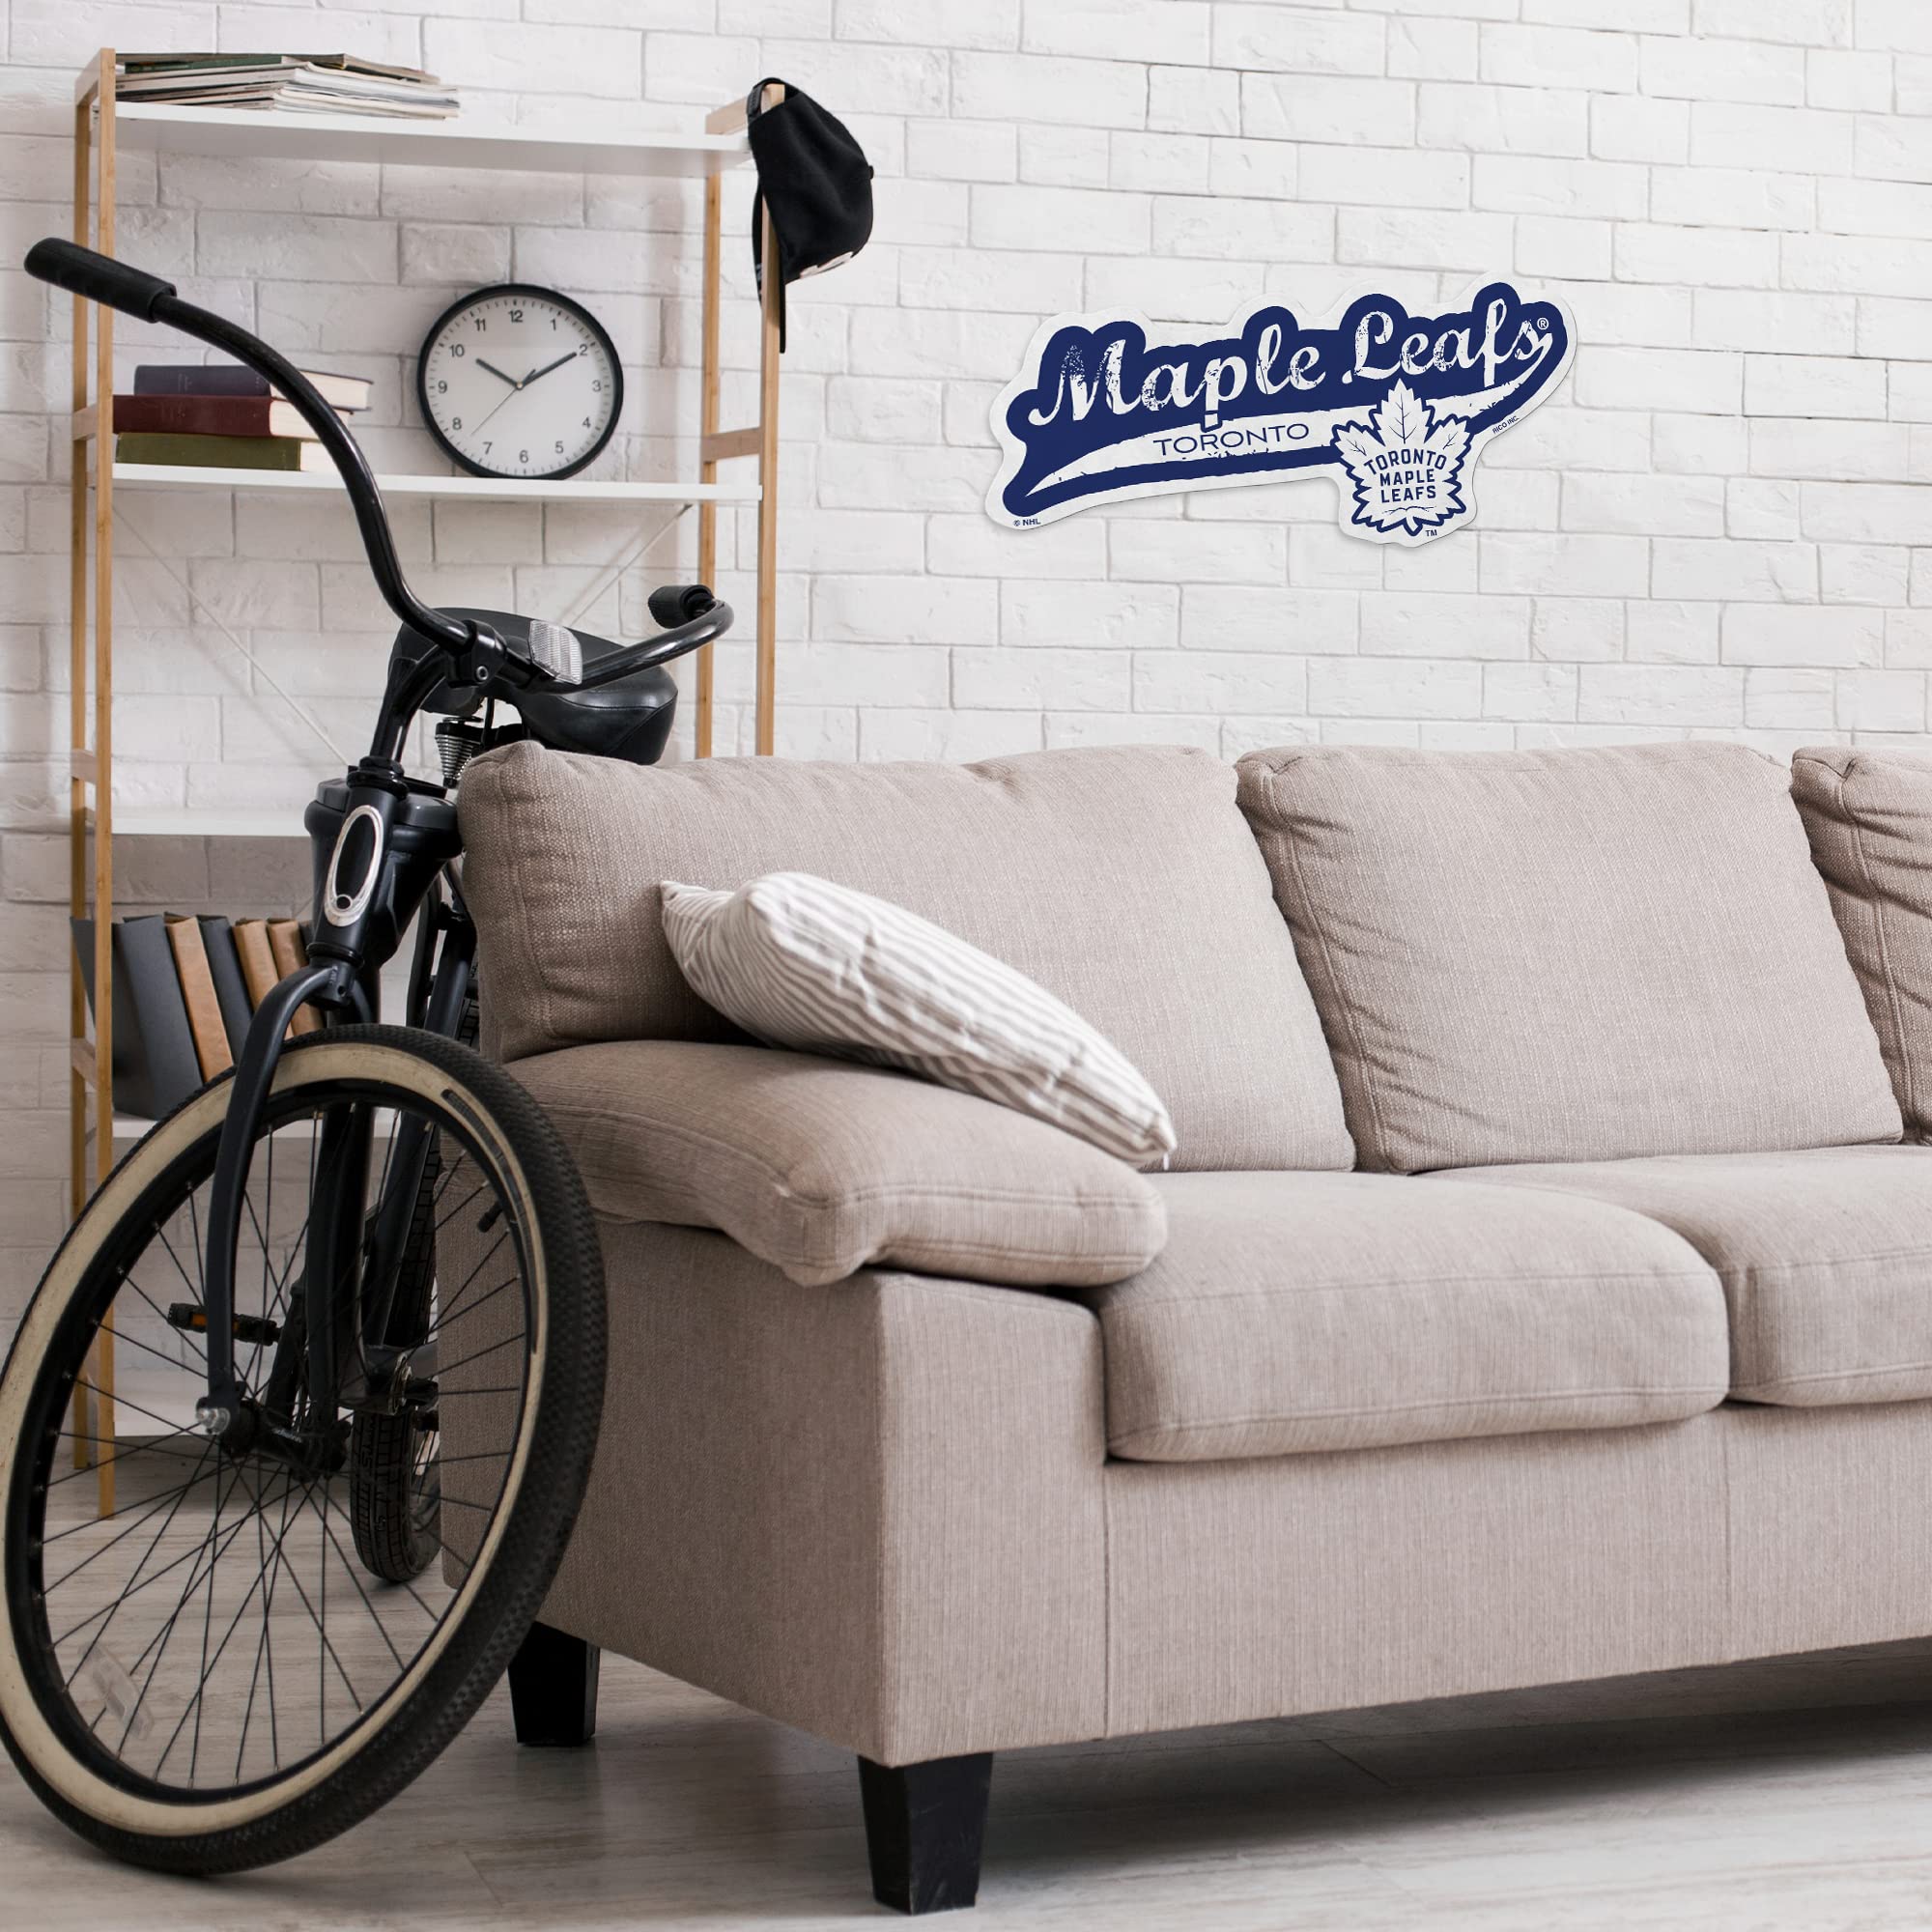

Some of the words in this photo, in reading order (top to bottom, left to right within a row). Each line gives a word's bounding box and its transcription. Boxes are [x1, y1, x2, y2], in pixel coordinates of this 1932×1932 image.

[508, 310, 524, 324] 12
[474, 318, 486, 331] 11
[550, 319, 557, 330] 1
[448, 344, 466, 357] 10
[579, 344, 588, 356] 2
[1028, 324, 1326, 428] Maple
[438, 381, 448, 394] 9
[591, 381, 602, 392] 3
[451, 417, 462, 431] 8
[582, 416, 591, 428] 4
[1152, 423, 1309, 456] TORONTO
[482, 441, 494, 455] 7
[554, 440, 565, 454] 5
[519, 450, 529, 464] 6
[1363, 448, 1447, 474] TORONTO
[1379, 469, 1435, 486] MAPLE
[1380, 485, 1436, 502] LEAFS
[1022, 518, 1040, 526] NHL
